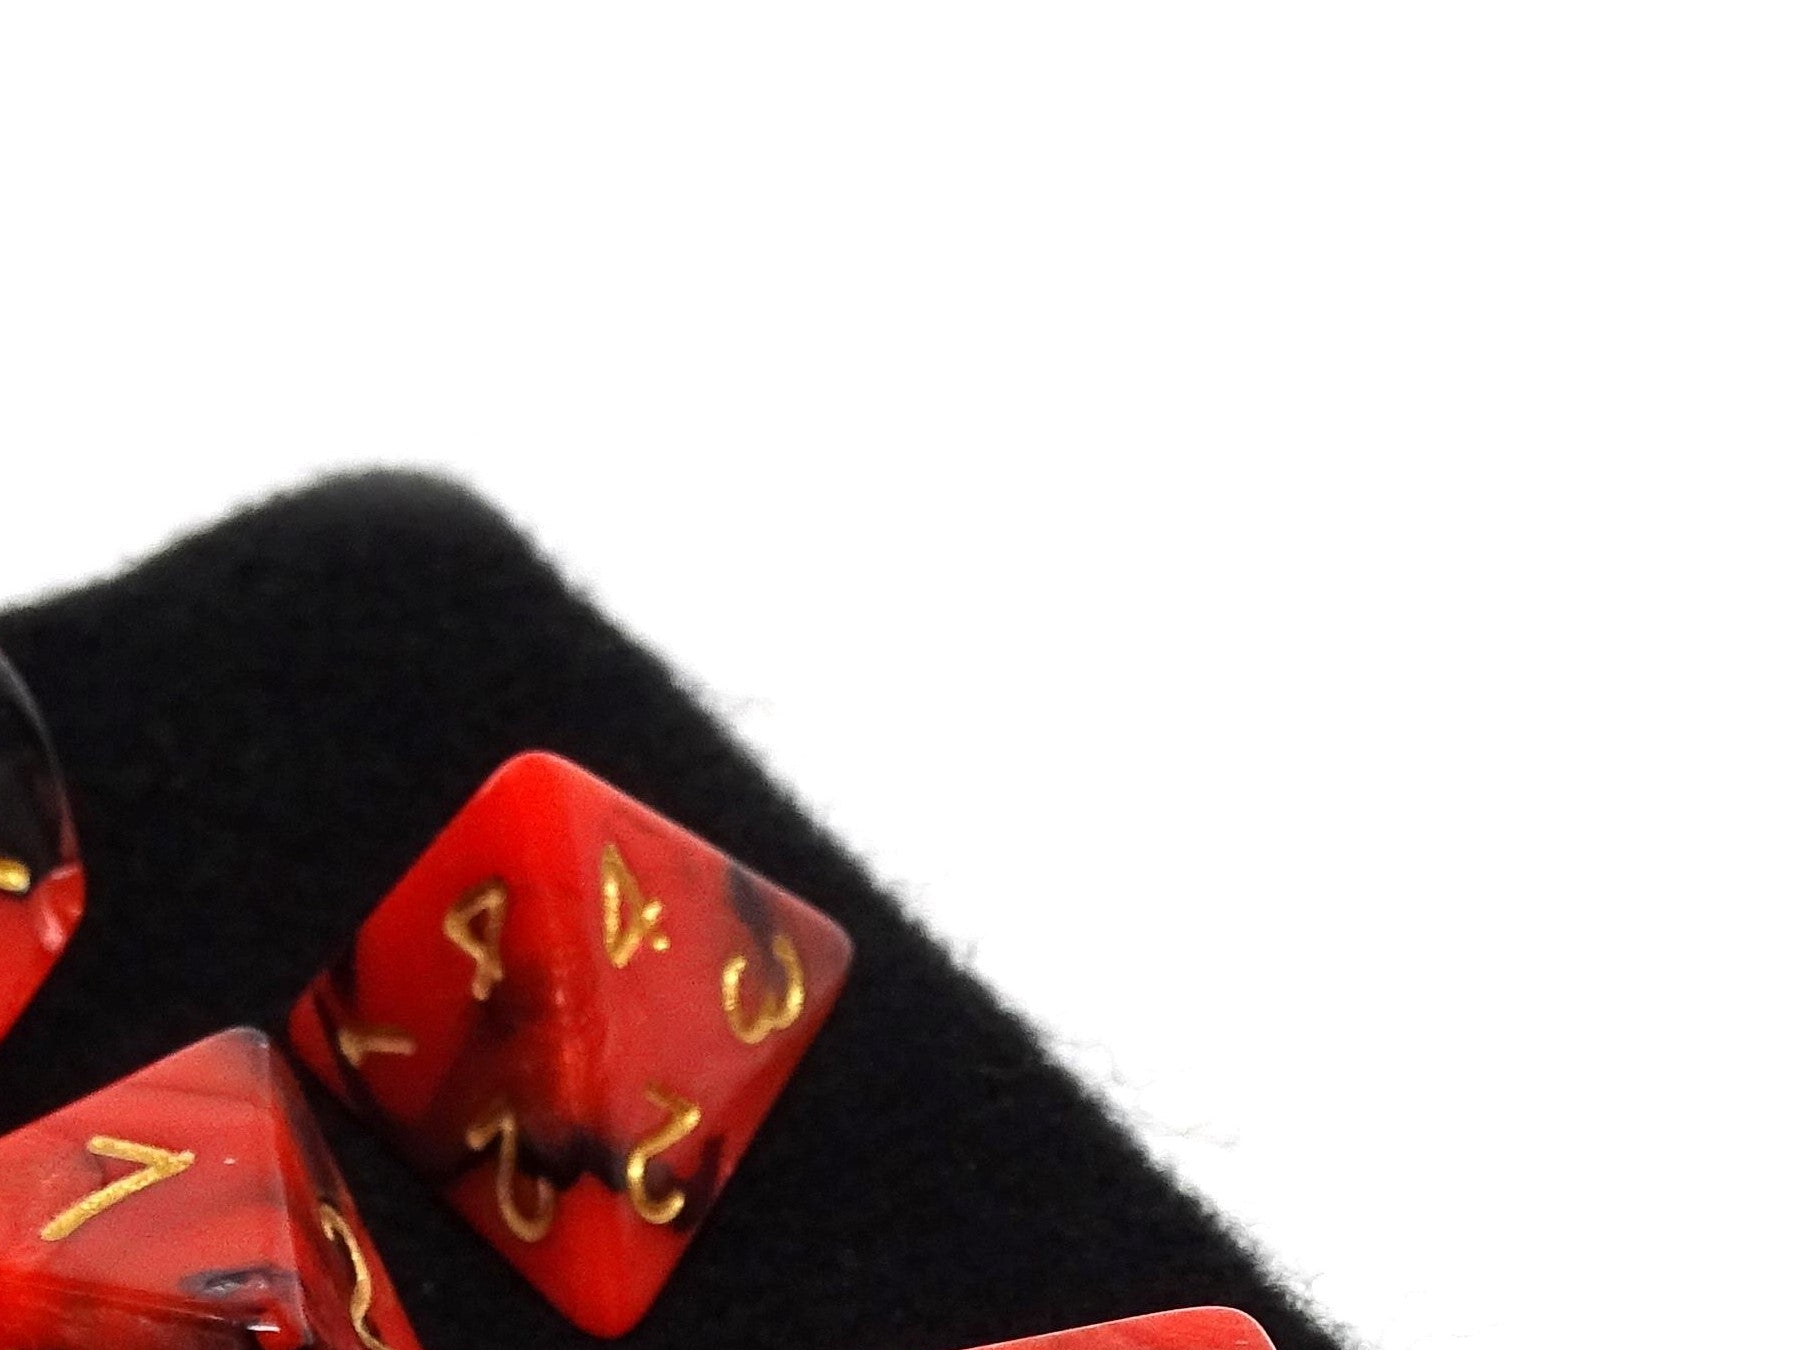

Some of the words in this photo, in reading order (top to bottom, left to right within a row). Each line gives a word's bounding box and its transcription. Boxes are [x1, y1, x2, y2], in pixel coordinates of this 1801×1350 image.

[442, 877, 507, 1002] 4
[601, 844, 671, 969] 4
[337, 1027, 417, 1068] 1
[720, 932, 805, 1045] 3
[41, 1136, 196, 1242] 7
[464, 1108, 555, 1243] 2
[626, 1082, 702, 1226] 2
